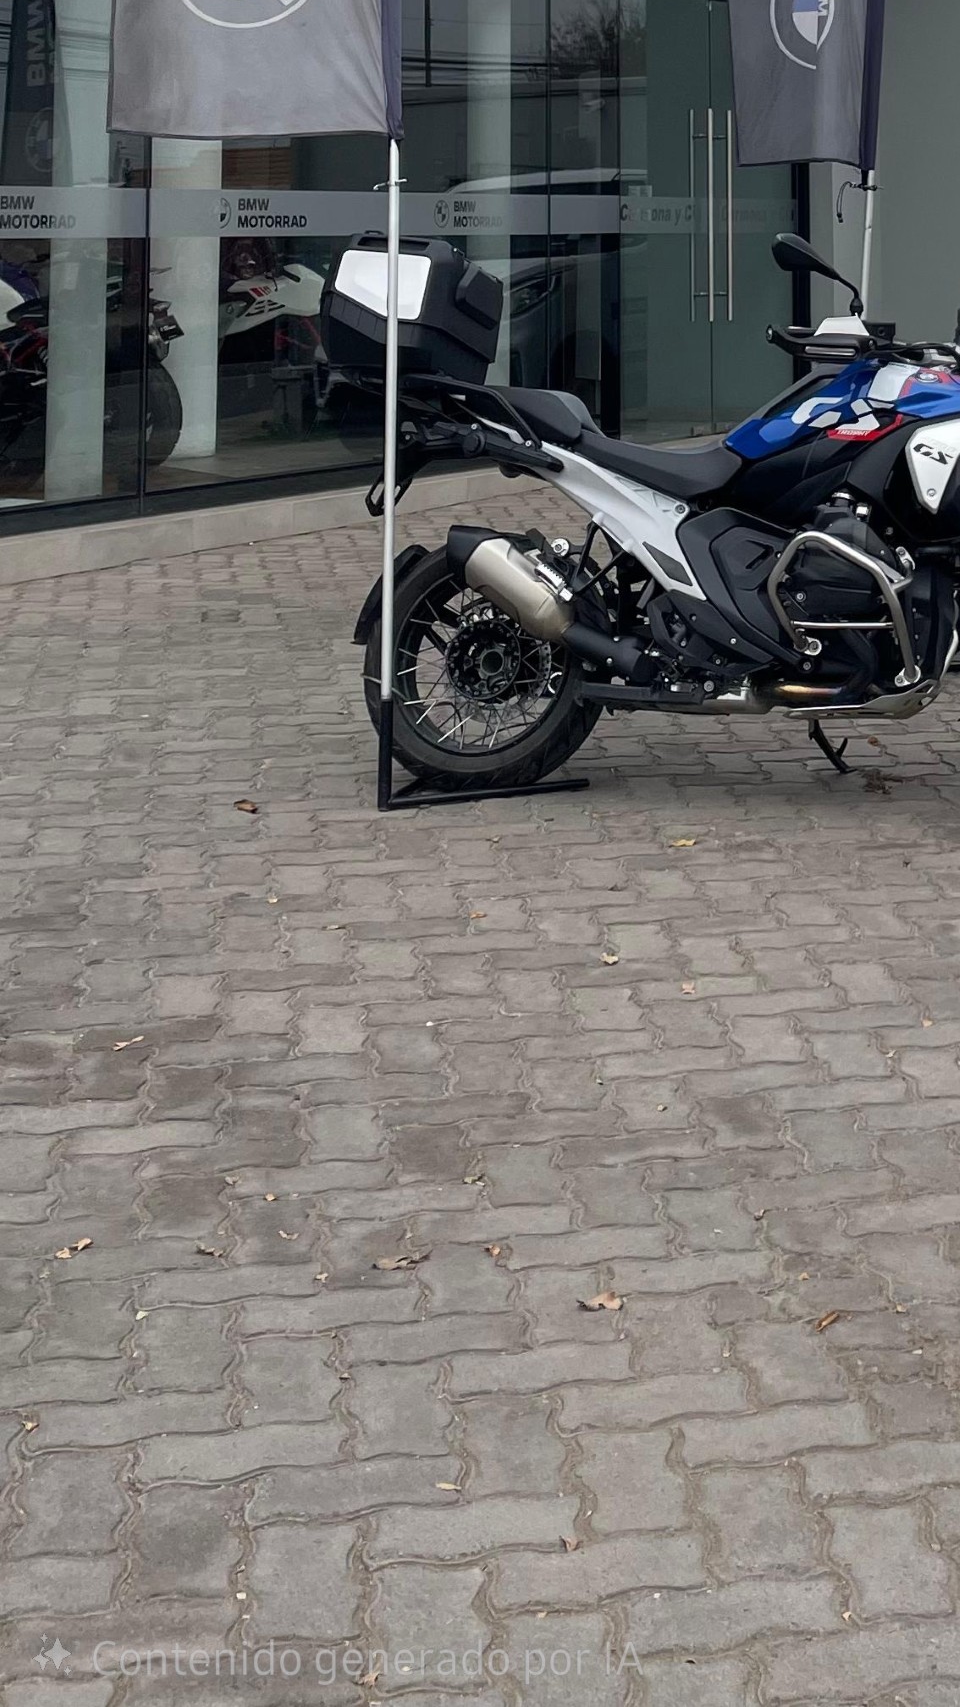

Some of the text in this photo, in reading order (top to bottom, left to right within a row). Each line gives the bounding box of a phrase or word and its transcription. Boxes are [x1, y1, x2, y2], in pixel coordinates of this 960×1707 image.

[0, 196, 35, 210] BMW
[237, 198, 270, 211] BMW
[453, 200, 476, 213] BMW
[0, 214, 76, 229] MOTORRAD
[237, 215, 308, 229] MOTORRAD
[453, 215, 503, 228] MOTORRAD
